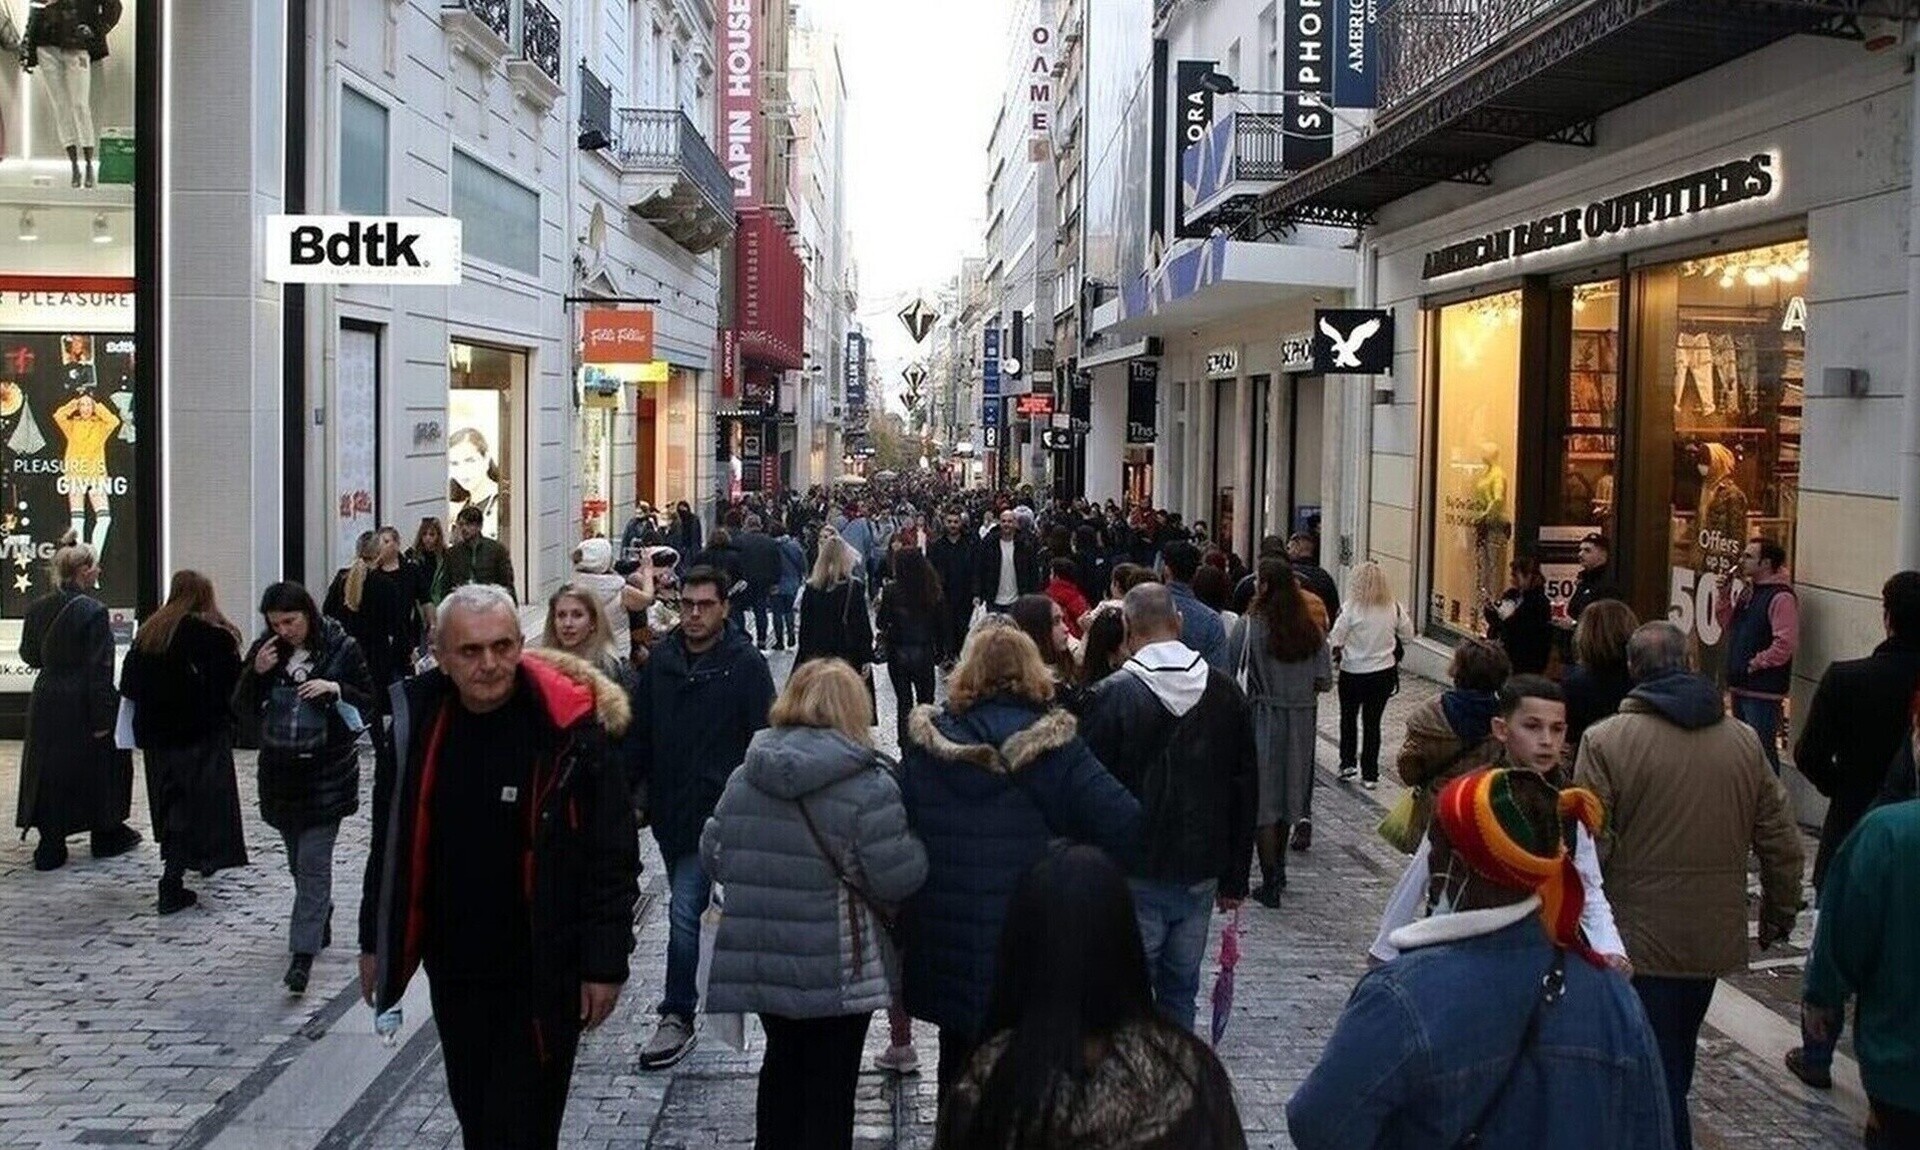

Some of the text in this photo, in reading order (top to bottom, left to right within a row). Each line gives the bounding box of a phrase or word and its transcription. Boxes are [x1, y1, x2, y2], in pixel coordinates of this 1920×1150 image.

[728, 0, 752, 197] LAPIN HOUSE
[1187, 92, 1204, 149] ORA
[1422, 154, 1772, 280] AMERICAN EAGLE OUTFITTERS
[18, 292, 130, 308] PLEASURE
[14, 459, 88, 474] PLEASURE
[56, 477, 128, 495] GIVING
[1700, 529, 1741, 554] Offers
